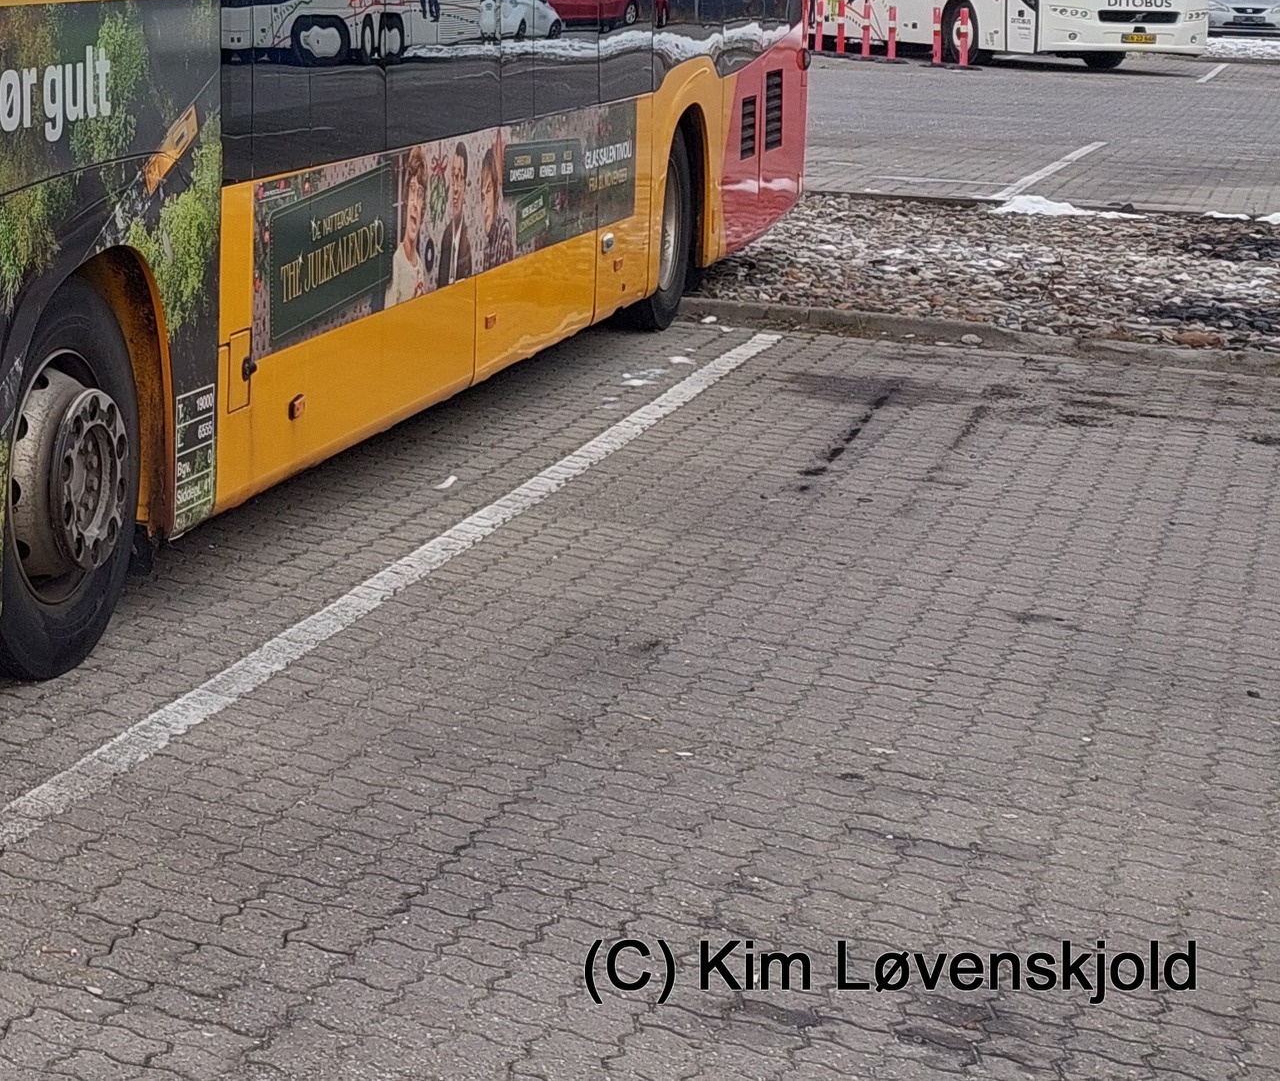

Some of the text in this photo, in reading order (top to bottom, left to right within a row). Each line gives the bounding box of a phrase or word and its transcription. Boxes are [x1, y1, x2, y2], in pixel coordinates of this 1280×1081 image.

[43, 45, 111, 142] gult
[281, 219, 385, 304] THE JULEKALENDER
